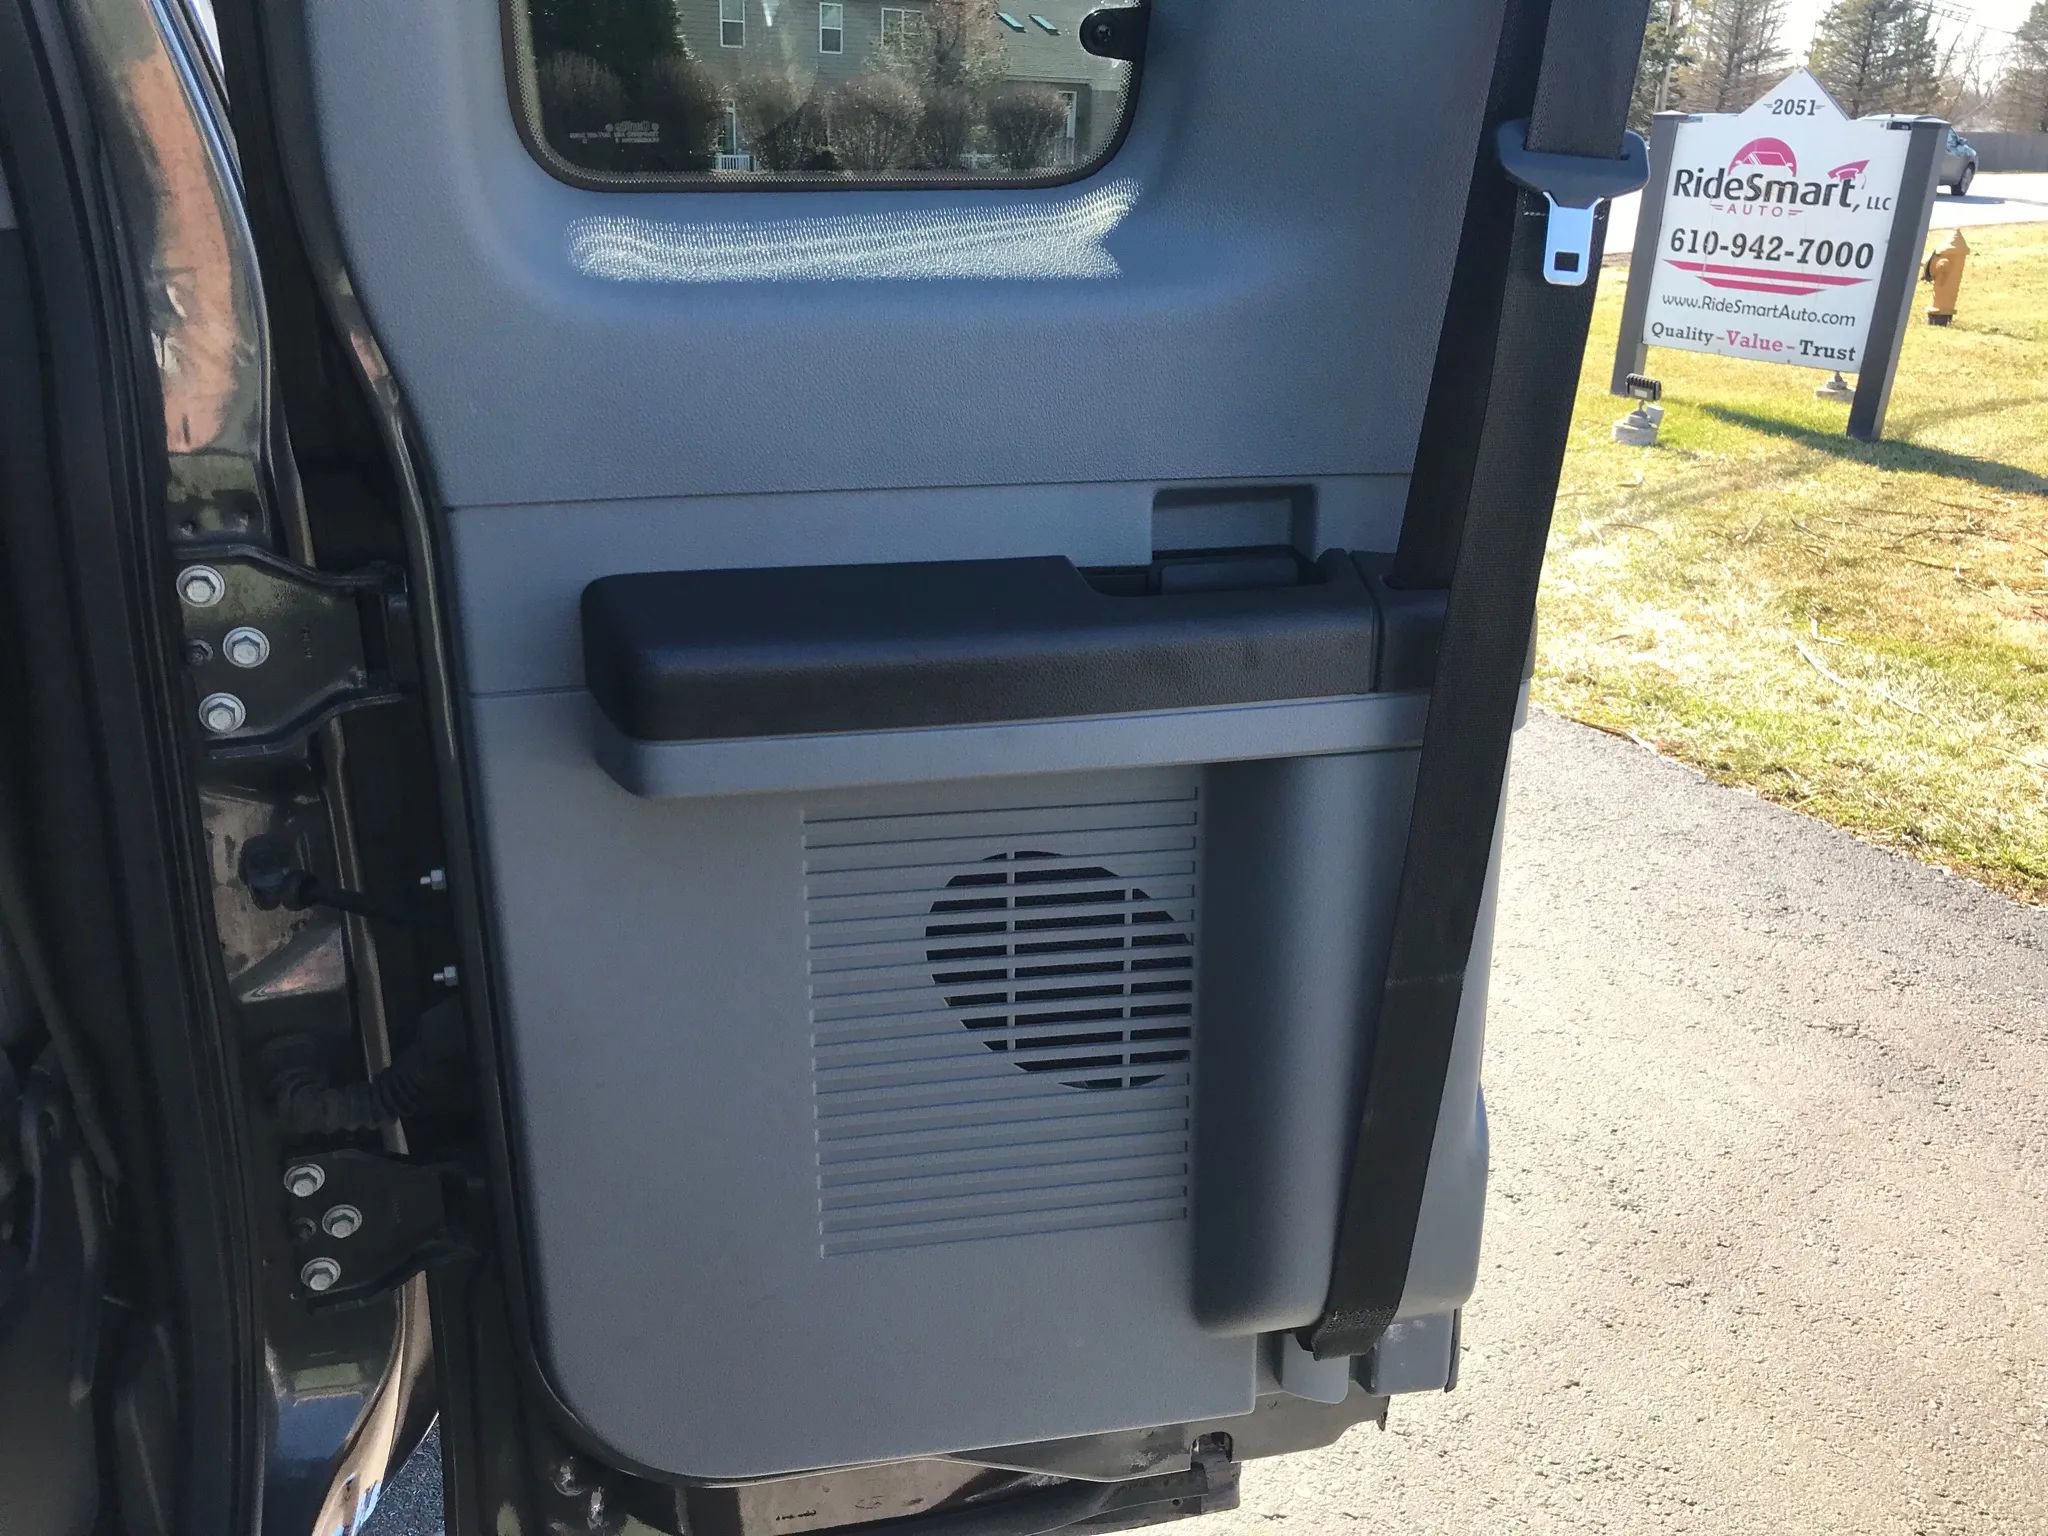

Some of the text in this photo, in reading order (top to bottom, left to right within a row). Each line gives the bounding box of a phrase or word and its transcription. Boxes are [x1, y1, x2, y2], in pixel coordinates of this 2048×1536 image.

[1771, 98, 1817, 116] 2051
[1672, 167, 1892, 213] RideSmart, LLC
[1727, 203, 1784, 217] AUTO
[1670, 228, 1874, 269] 610-942-7000
[1662, 294, 1856, 327] www.RideSmartAuto.com
